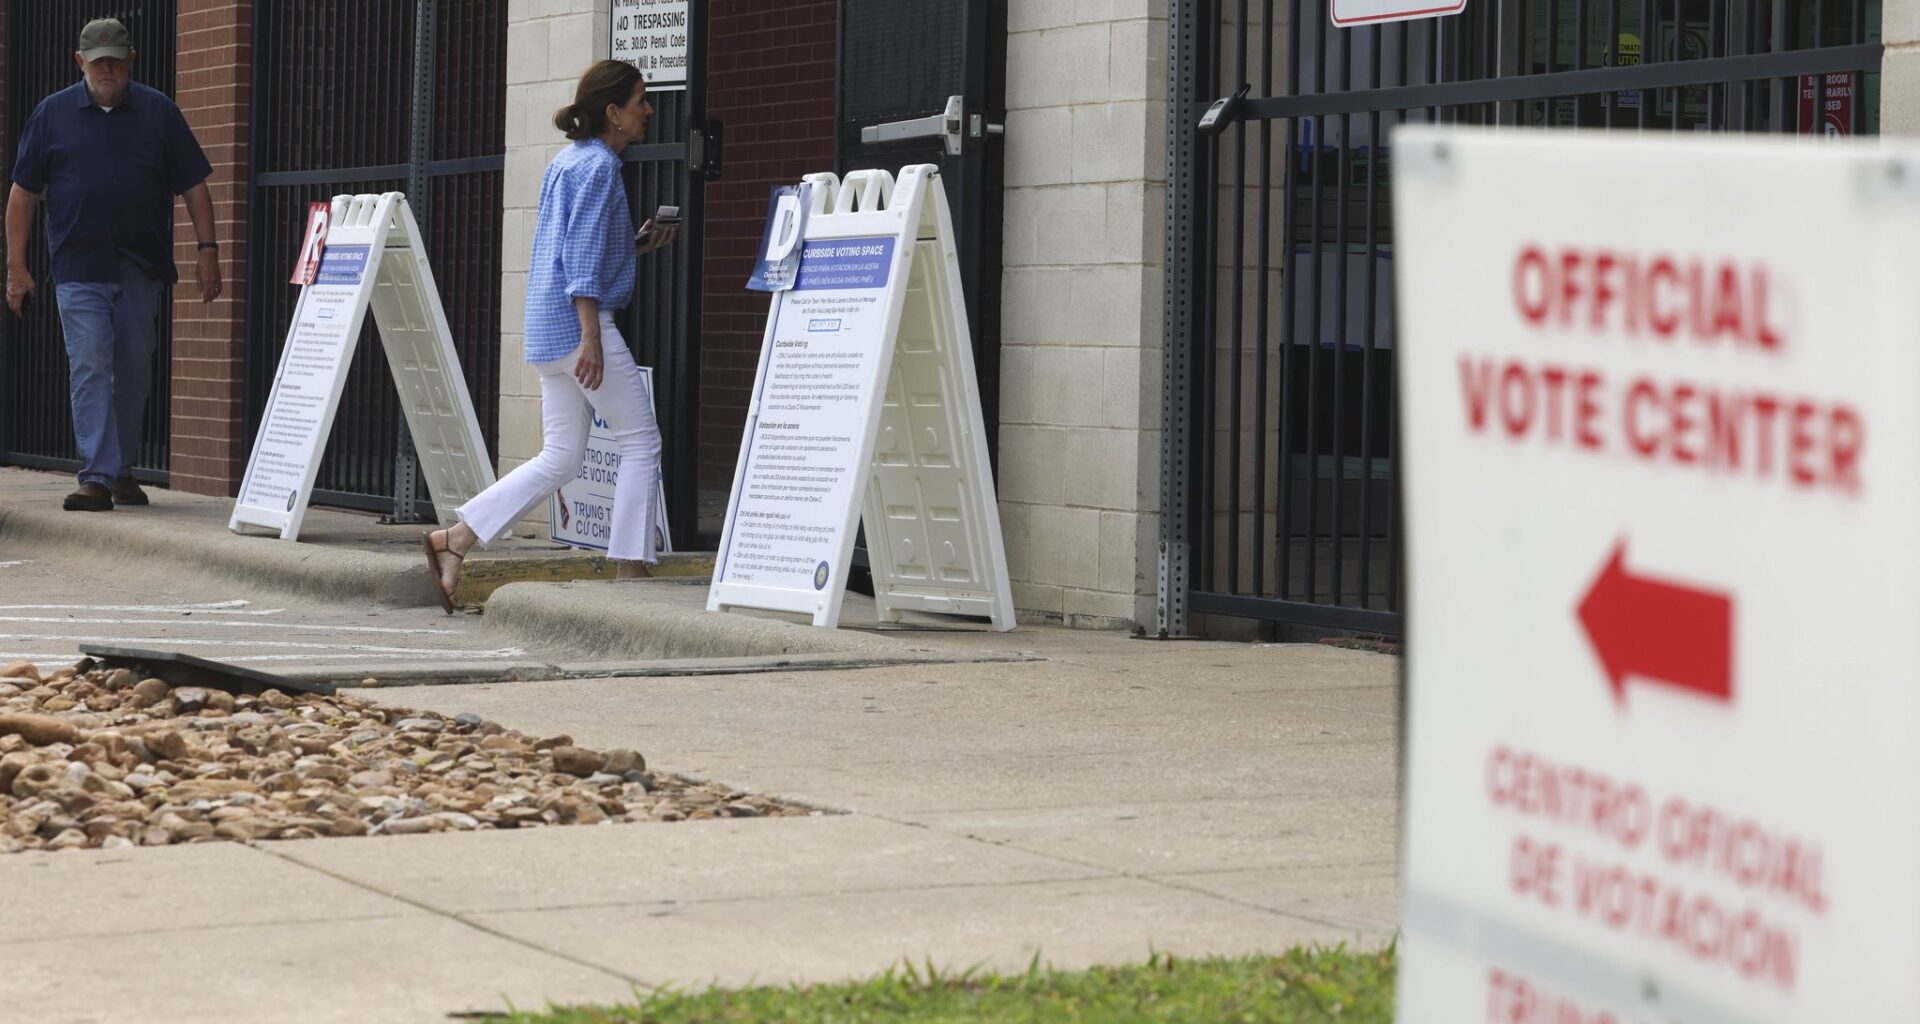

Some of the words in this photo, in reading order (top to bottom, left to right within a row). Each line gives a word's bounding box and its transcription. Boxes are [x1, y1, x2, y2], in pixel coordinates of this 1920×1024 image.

[616, 16, 628, 30] NO
[634, 12, 685, 29] TRESPASSING
[616, 38, 628, 50] Sec.
[631, 36, 648, 50] 30.05
[650, 34, 667, 48] Penal
[670, 33, 686, 47] Code
[638, 55, 648, 69] Will
[650, 56, 657, 69] Be
[304, 210, 328, 262] R
[765, 196, 801, 261] D
[803, 248, 836, 258] CURBSIDE
[836, 247, 860, 257] VOTING
[861, 245, 884, 255] SPACE
[1512, 242, 1784, 357] OFFICIAL
[1459, 353, 1602, 454] VOTE
[1624, 374, 1866, 498] CENTER
[590, 466, 618, 486] VOTAC
[574, 501, 604, 520] TRUNG
[1485, 743, 1651, 850] CENTRO
[1657, 793, 1831, 917] OFICIAL
[1510, 833, 1564, 909] DE
[1571, 857, 1801, 996] VOTACIÓN
